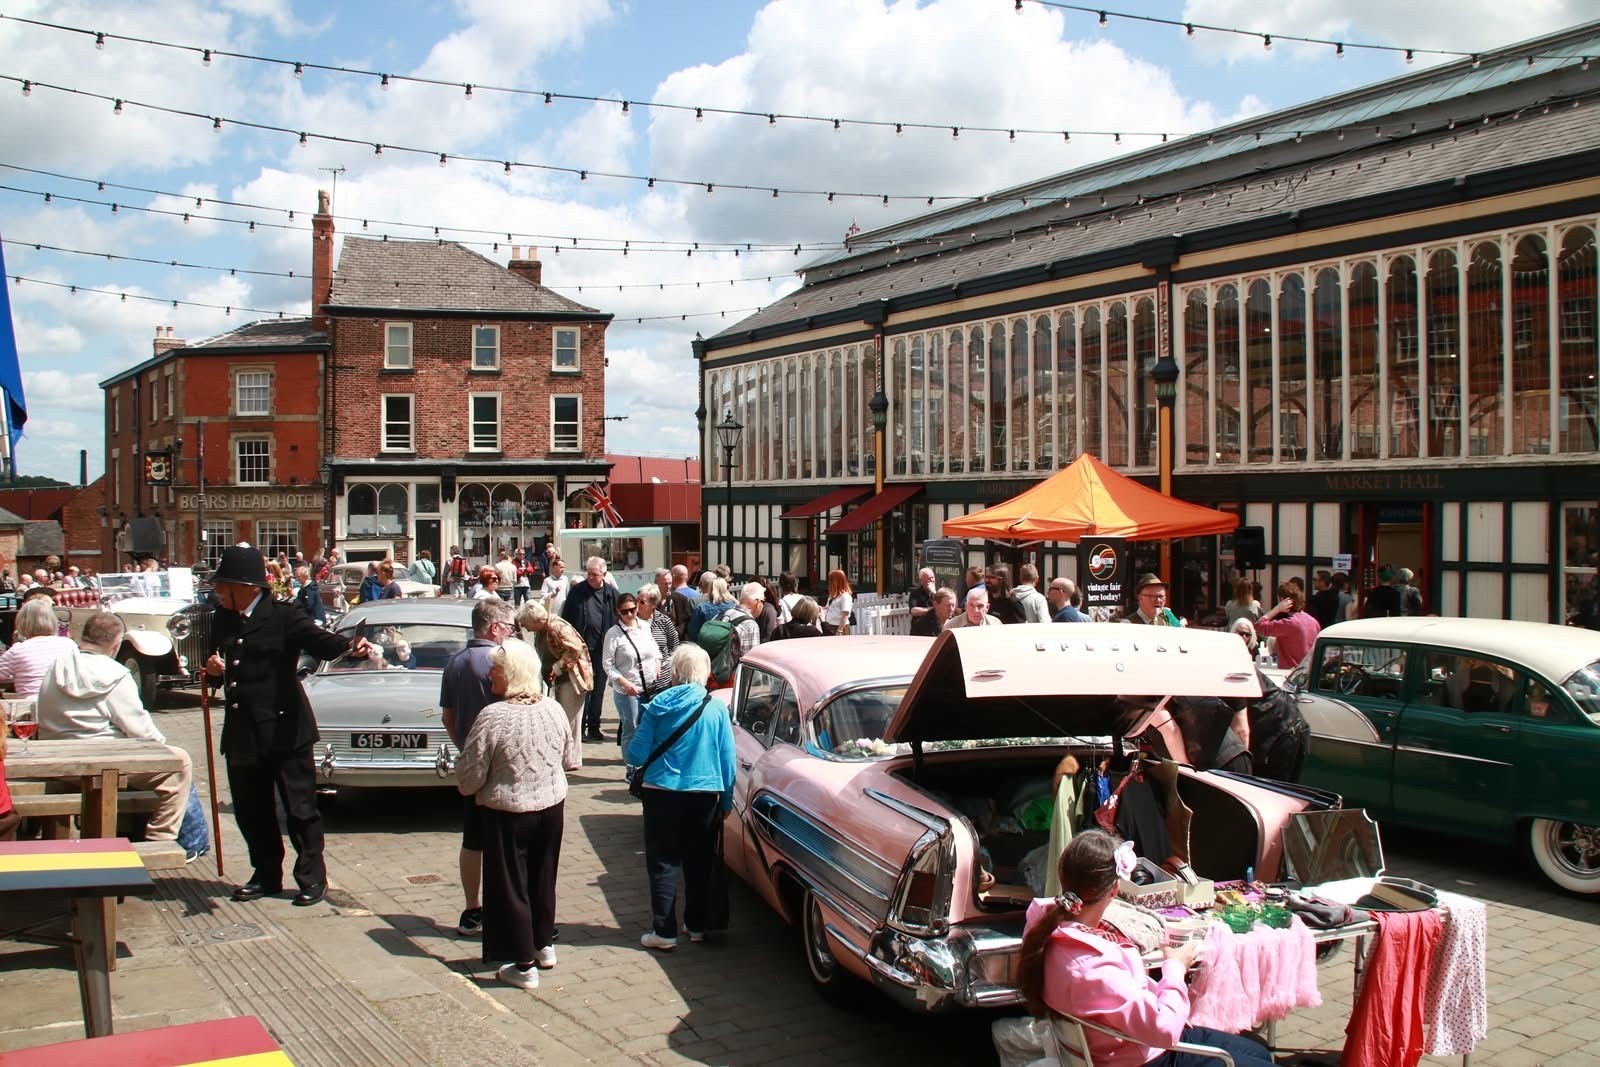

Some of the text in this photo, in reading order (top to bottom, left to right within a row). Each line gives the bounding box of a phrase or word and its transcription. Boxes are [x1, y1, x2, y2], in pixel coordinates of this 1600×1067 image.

[1326, 472, 1444, 489] MARKET HALL
[180, 493, 321, 509] BOARS HEAD HOTEL
[1087, 582, 1122, 592] vintage fair
[1087, 592, 1121, 602] here today!
[357, 733, 422, 748] 615 PNY
